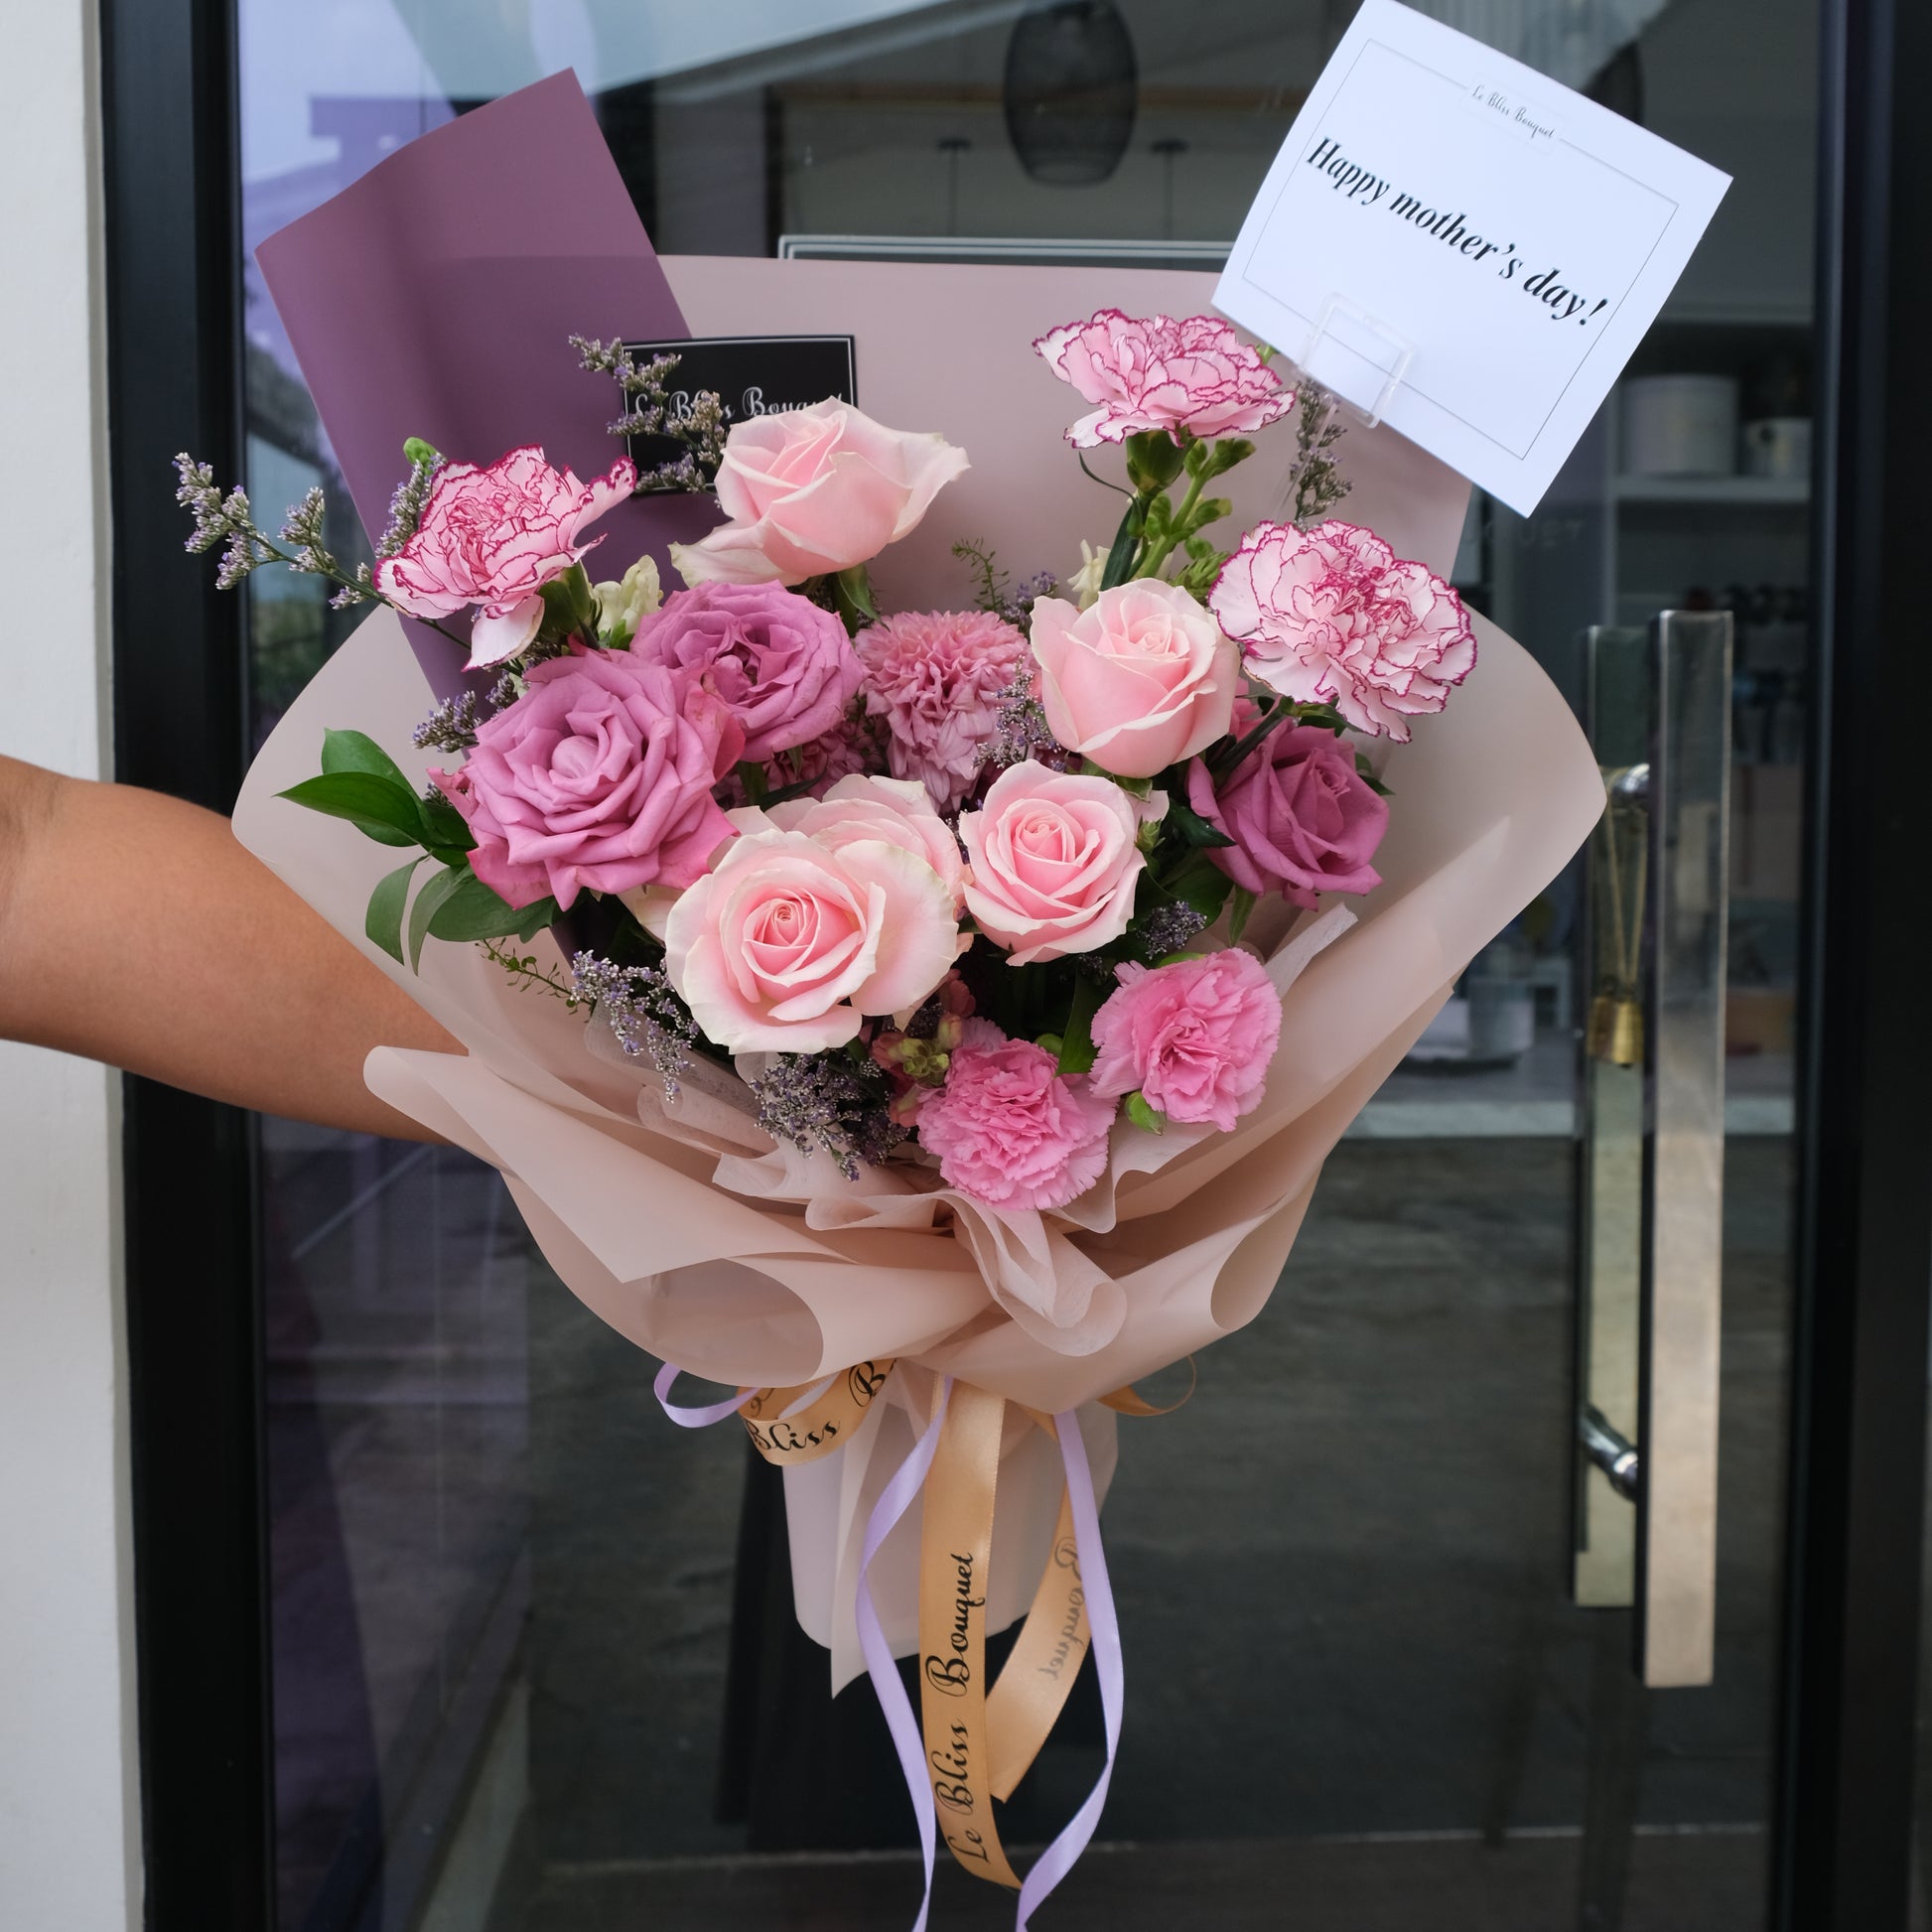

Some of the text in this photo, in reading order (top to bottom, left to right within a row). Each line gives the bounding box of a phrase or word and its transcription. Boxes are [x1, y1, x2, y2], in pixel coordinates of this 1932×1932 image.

[1488, 92, 1510, 115] Bliss
[1514, 106, 1556, 139] Bouquet
[1307, 136, 1608, 326] Happy mother’s day!
[924, 1552, 991, 1863] Le Bliss Bouquet
